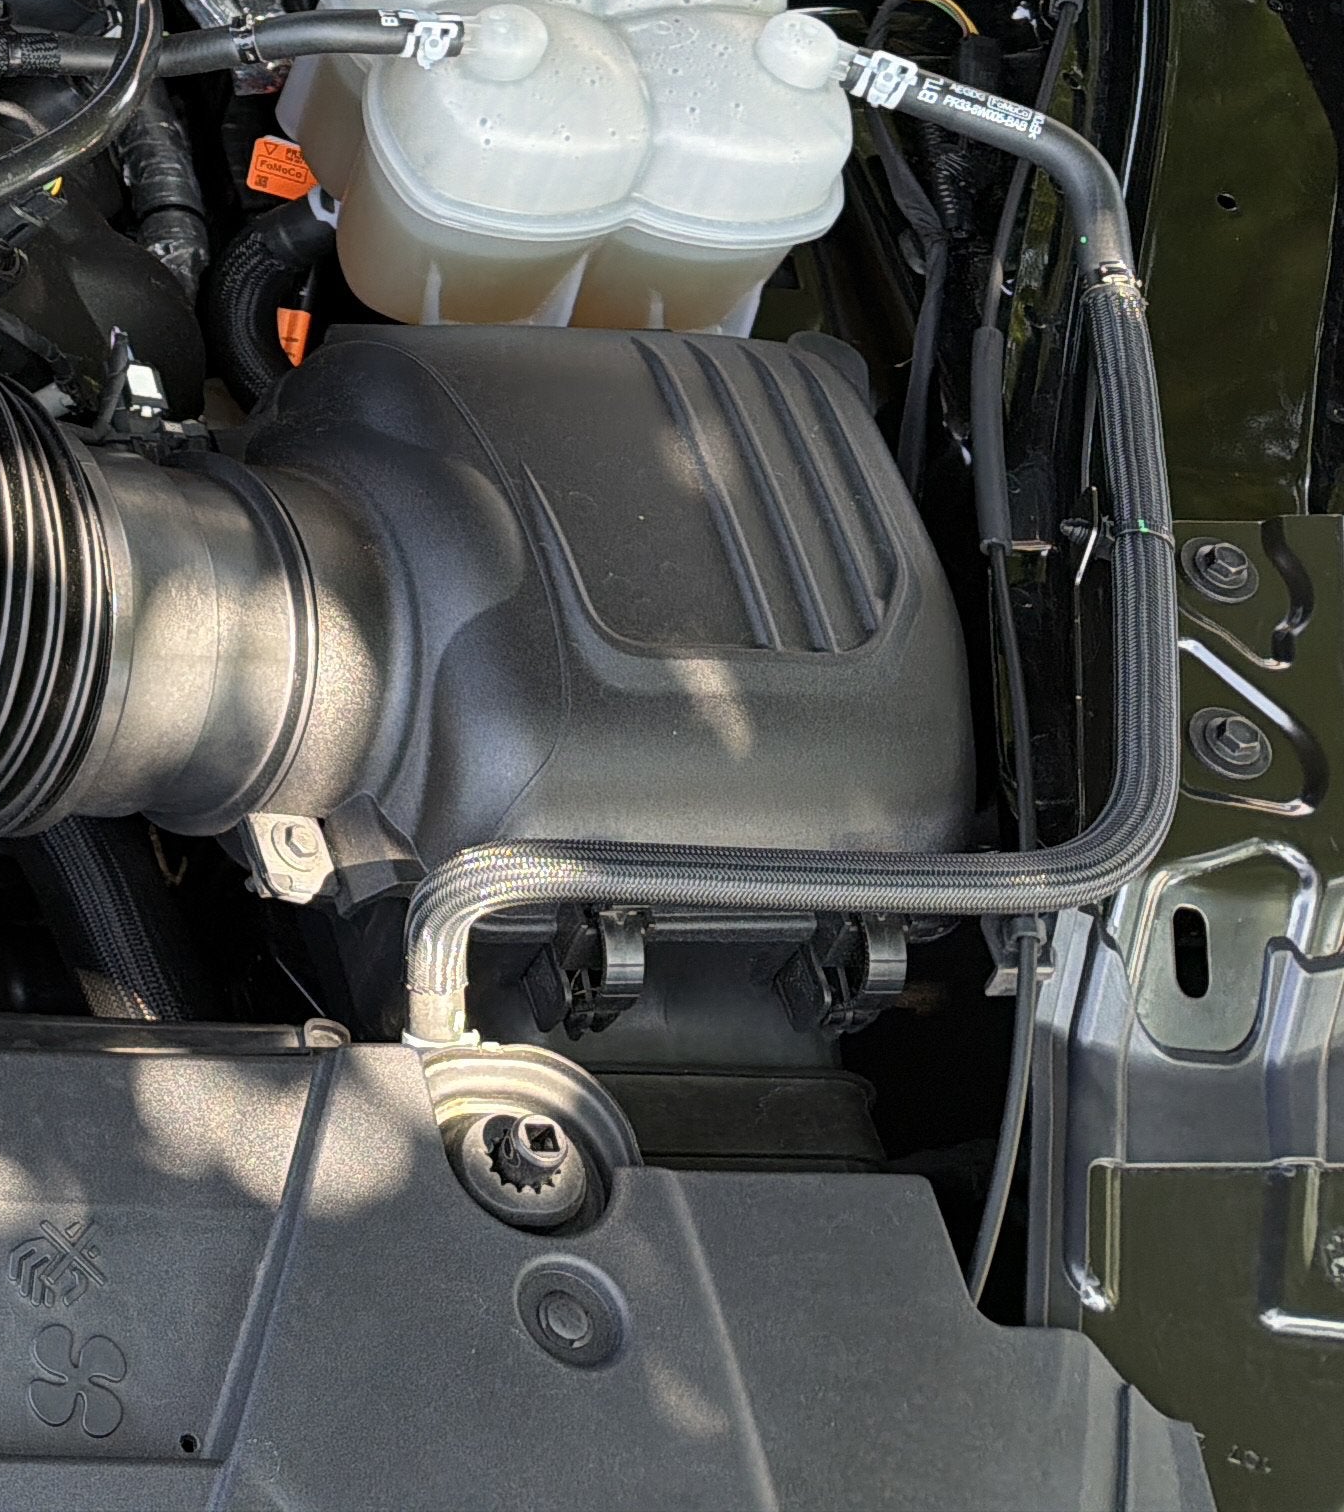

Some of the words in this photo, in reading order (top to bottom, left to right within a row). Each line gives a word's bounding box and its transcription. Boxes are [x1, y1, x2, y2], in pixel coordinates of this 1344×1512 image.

[916, 77, 945, 104] BTL
[989, 97, 1031, 119] FoMoCo
[259, 159, 302, 179] FoMoCo
